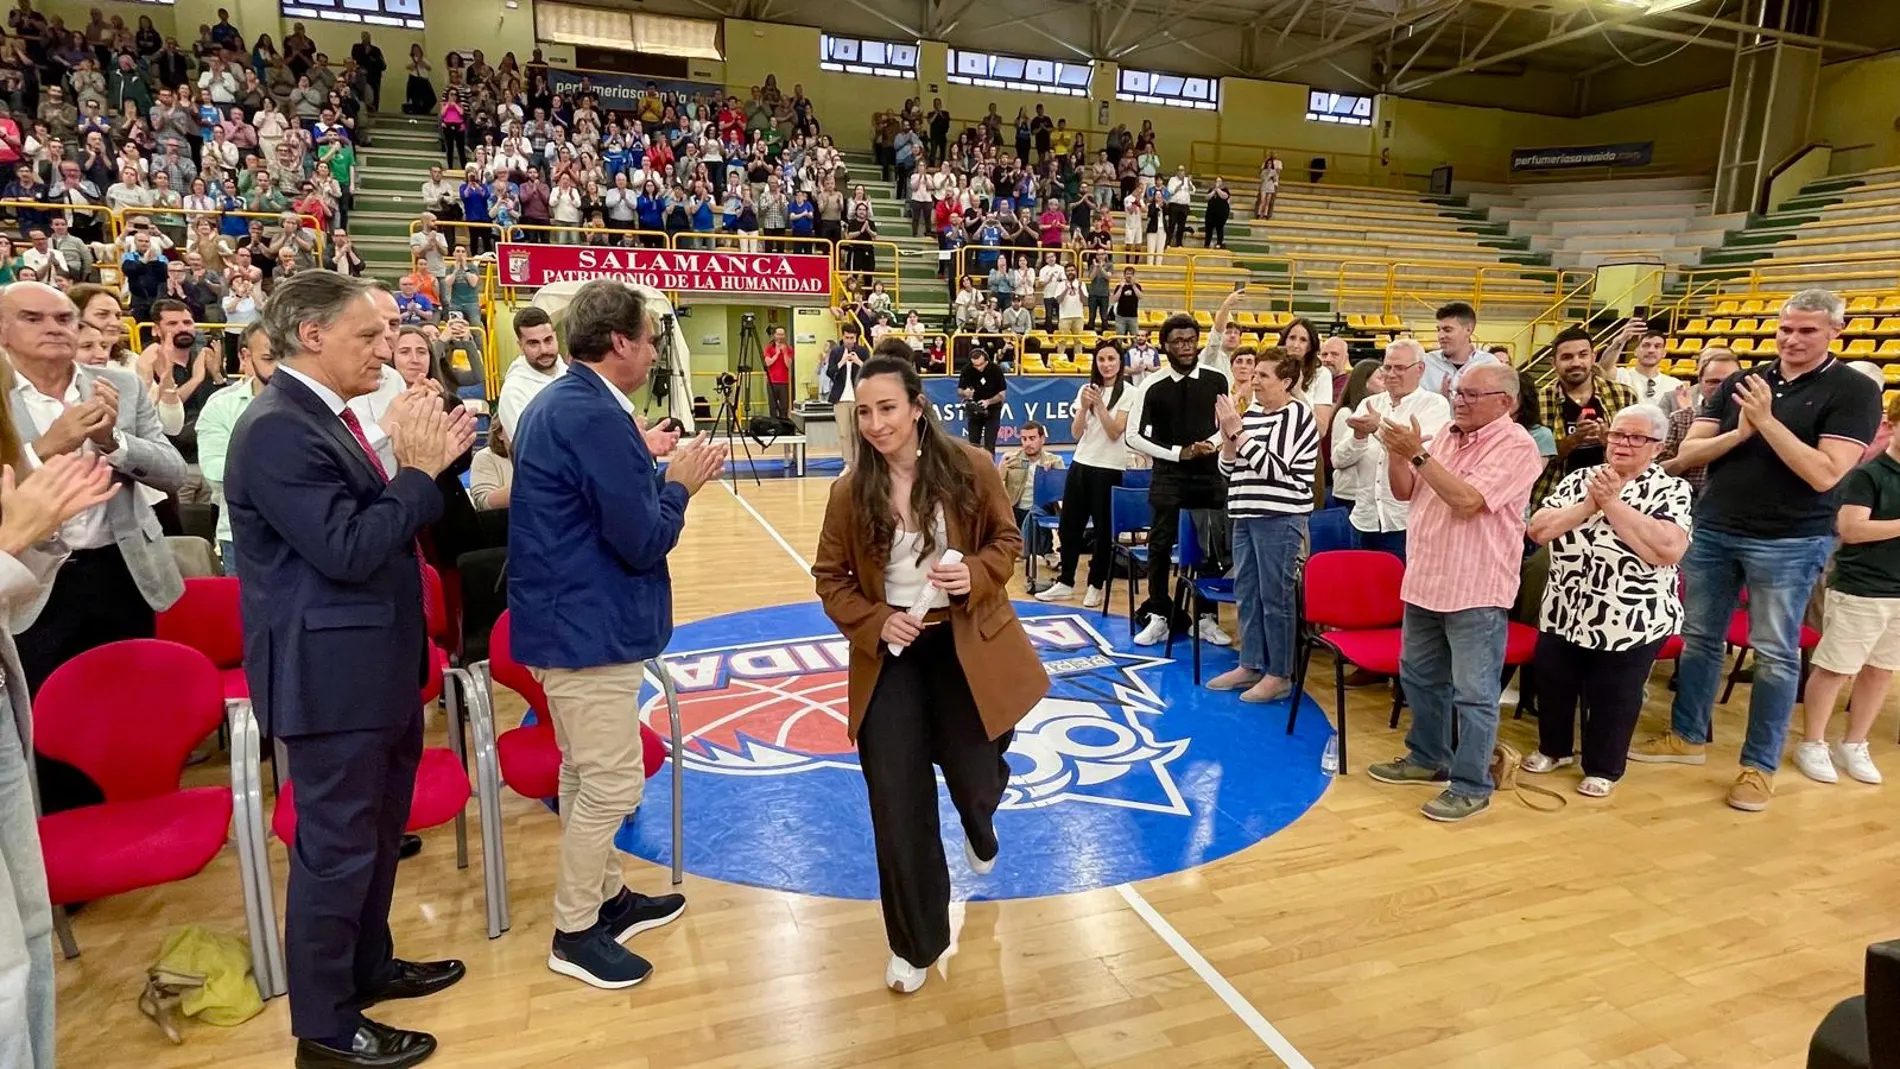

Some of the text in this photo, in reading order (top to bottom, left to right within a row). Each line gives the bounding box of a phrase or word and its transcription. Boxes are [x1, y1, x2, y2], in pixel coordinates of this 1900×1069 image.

[579, 250, 795, 275] SALAMANCA
[664, 273, 689, 288] DE
[694, 275, 716, 289] LA
[721, 275, 822, 292] HUMANIDAD
[1024, 402, 1039, 421] Y
